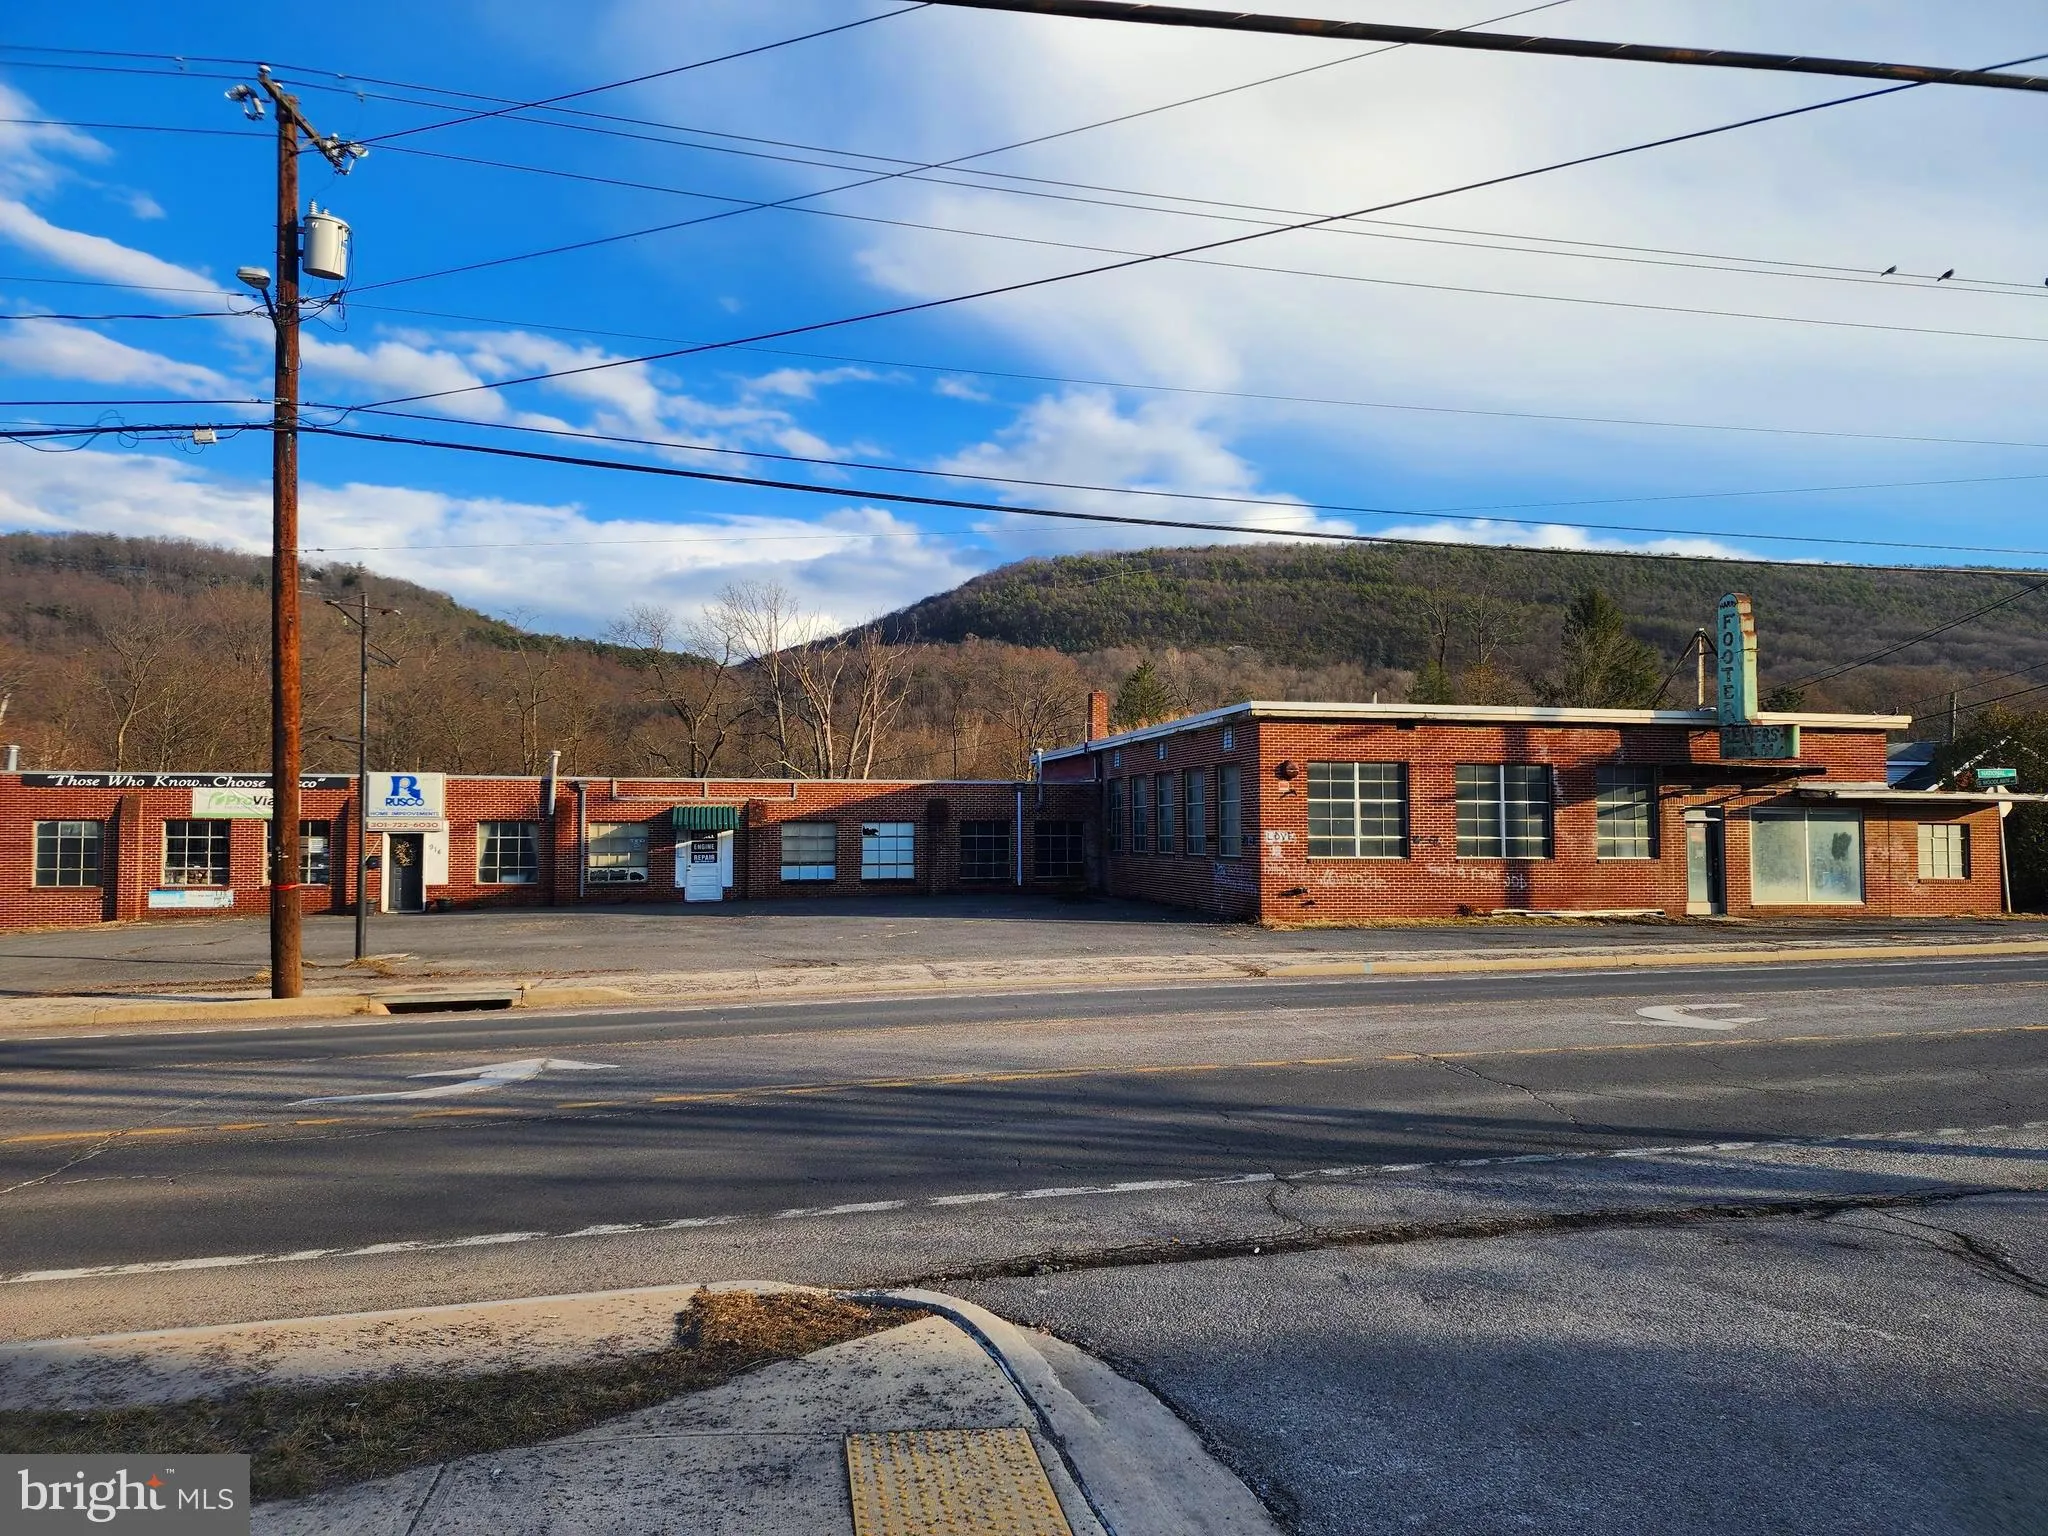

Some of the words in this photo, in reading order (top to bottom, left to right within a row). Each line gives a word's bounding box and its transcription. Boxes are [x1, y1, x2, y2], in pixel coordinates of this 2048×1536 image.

[1721, 613, 1736, 721] FOOTER
[108, 775, 145, 787] Who
[390, 775, 421, 799] R
[385, 797, 425, 807] RUSCO
[1266, 831, 1295, 841] LOVE
[693, 843, 716, 851] ENGINE
[1504, 873, 1527, 889] job
